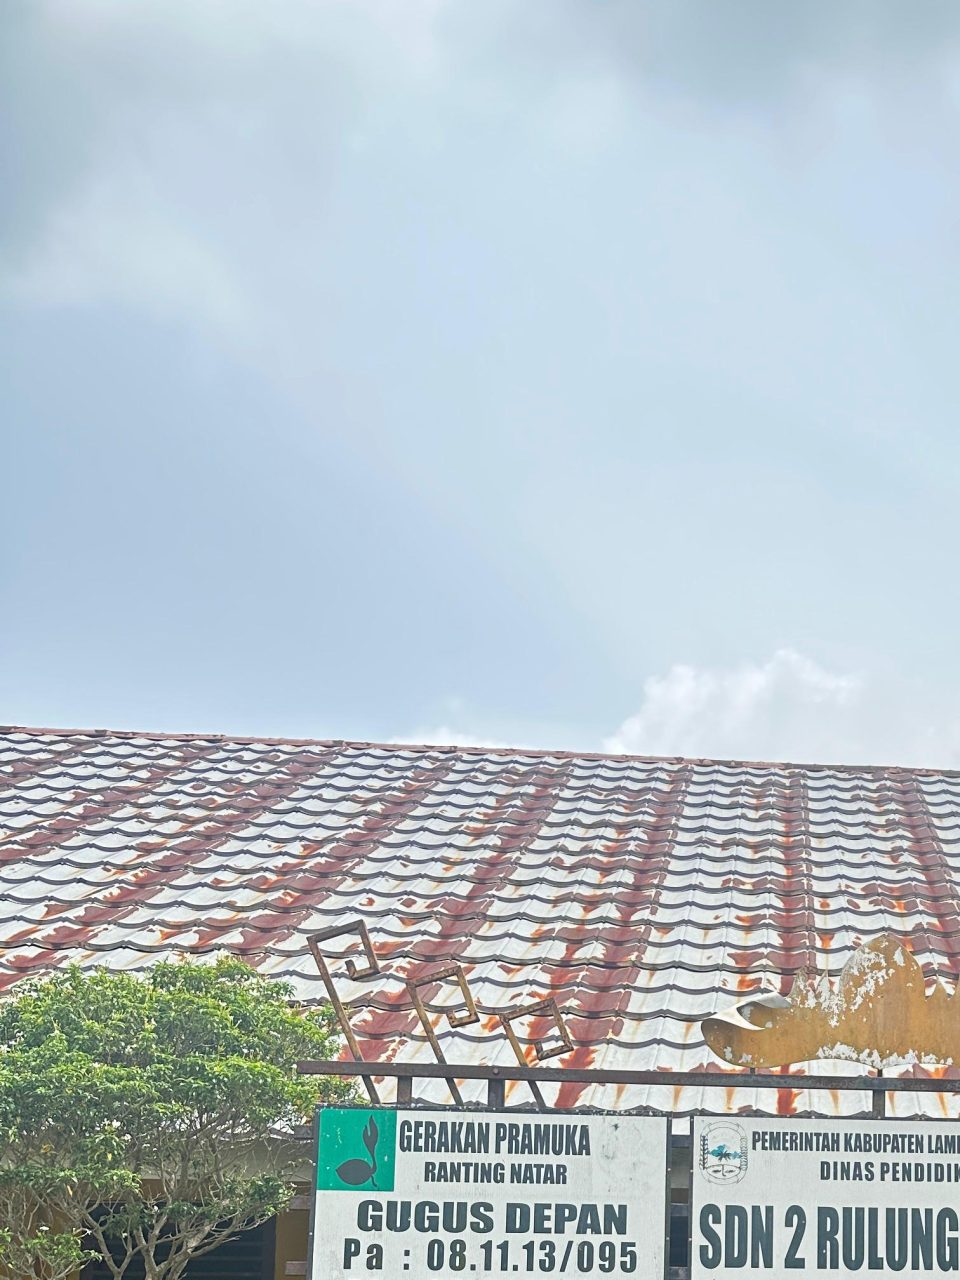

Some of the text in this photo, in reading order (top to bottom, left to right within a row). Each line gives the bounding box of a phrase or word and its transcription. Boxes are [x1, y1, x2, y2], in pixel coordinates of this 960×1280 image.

[400, 1120, 590, 1155] GERAKAN PRAMUKA
[752, 1131, 839, 1151] PEMERINTAH
[844, 1133, 923, 1153] KABUPATEN
[425, 1162, 567, 1184] RANTING NATAR
[821, 1161, 874, 1181] DINAS
[357, 1200, 627, 1235] GUGUS DEPAN
[344, 1238, 383, 1270] Pa
[427, 1239, 636, 1273] 08.11.13/095
[700, 1204, 773, 1269] SDN
[785, 1205, 806, 1269] 2
[817, 1207, 958, 1272] RULUNG
